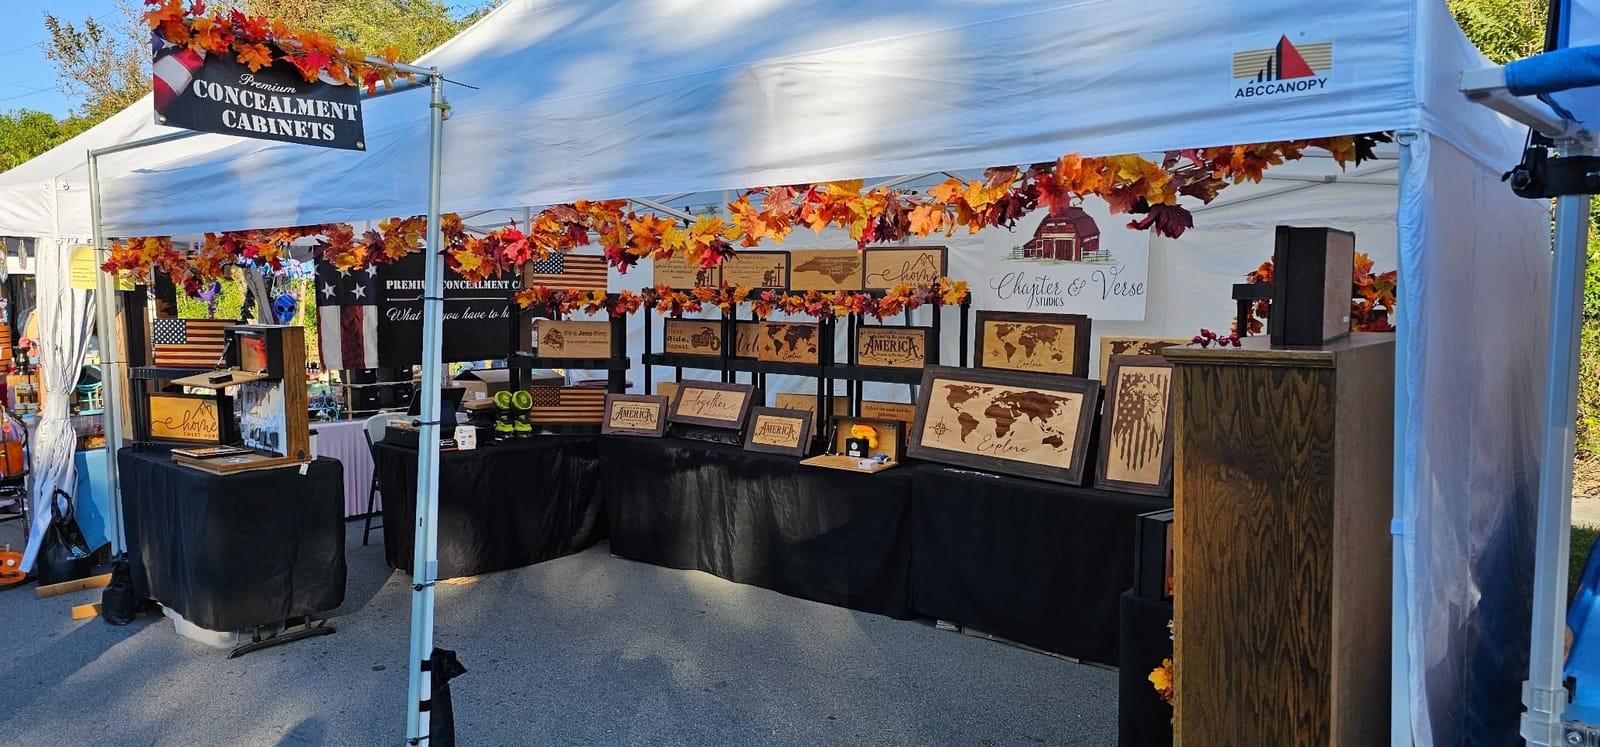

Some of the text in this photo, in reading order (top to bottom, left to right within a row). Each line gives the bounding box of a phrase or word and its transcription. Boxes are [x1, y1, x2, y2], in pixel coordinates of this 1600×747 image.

[239, 73, 297, 94] Premium
[1234, 78, 1328, 98] ABCCANOPY
[193, 79, 358, 121] CONCEALMENT
[222, 109, 336, 141] CABINETS
[386, 279, 425, 290] PREMIU
[990, 265, 1145, 310] Chapter & Verse
[1034, 297, 1065, 307] STUDIOS
[386, 307, 422, 321] What
[461, 306, 487, 320] have
[488, 307, 499, 320] to
[578, 330, 593, 338] Jeep
[667, 335, 690, 343] Ride.
[860, 335, 923, 359] AMERICA
[1016, 358, 1043, 369] Explore
[614, 407, 655, 424] AMERICA
[757, 421, 797, 441] AMERICA
[977, 433, 1030, 456] Explore
